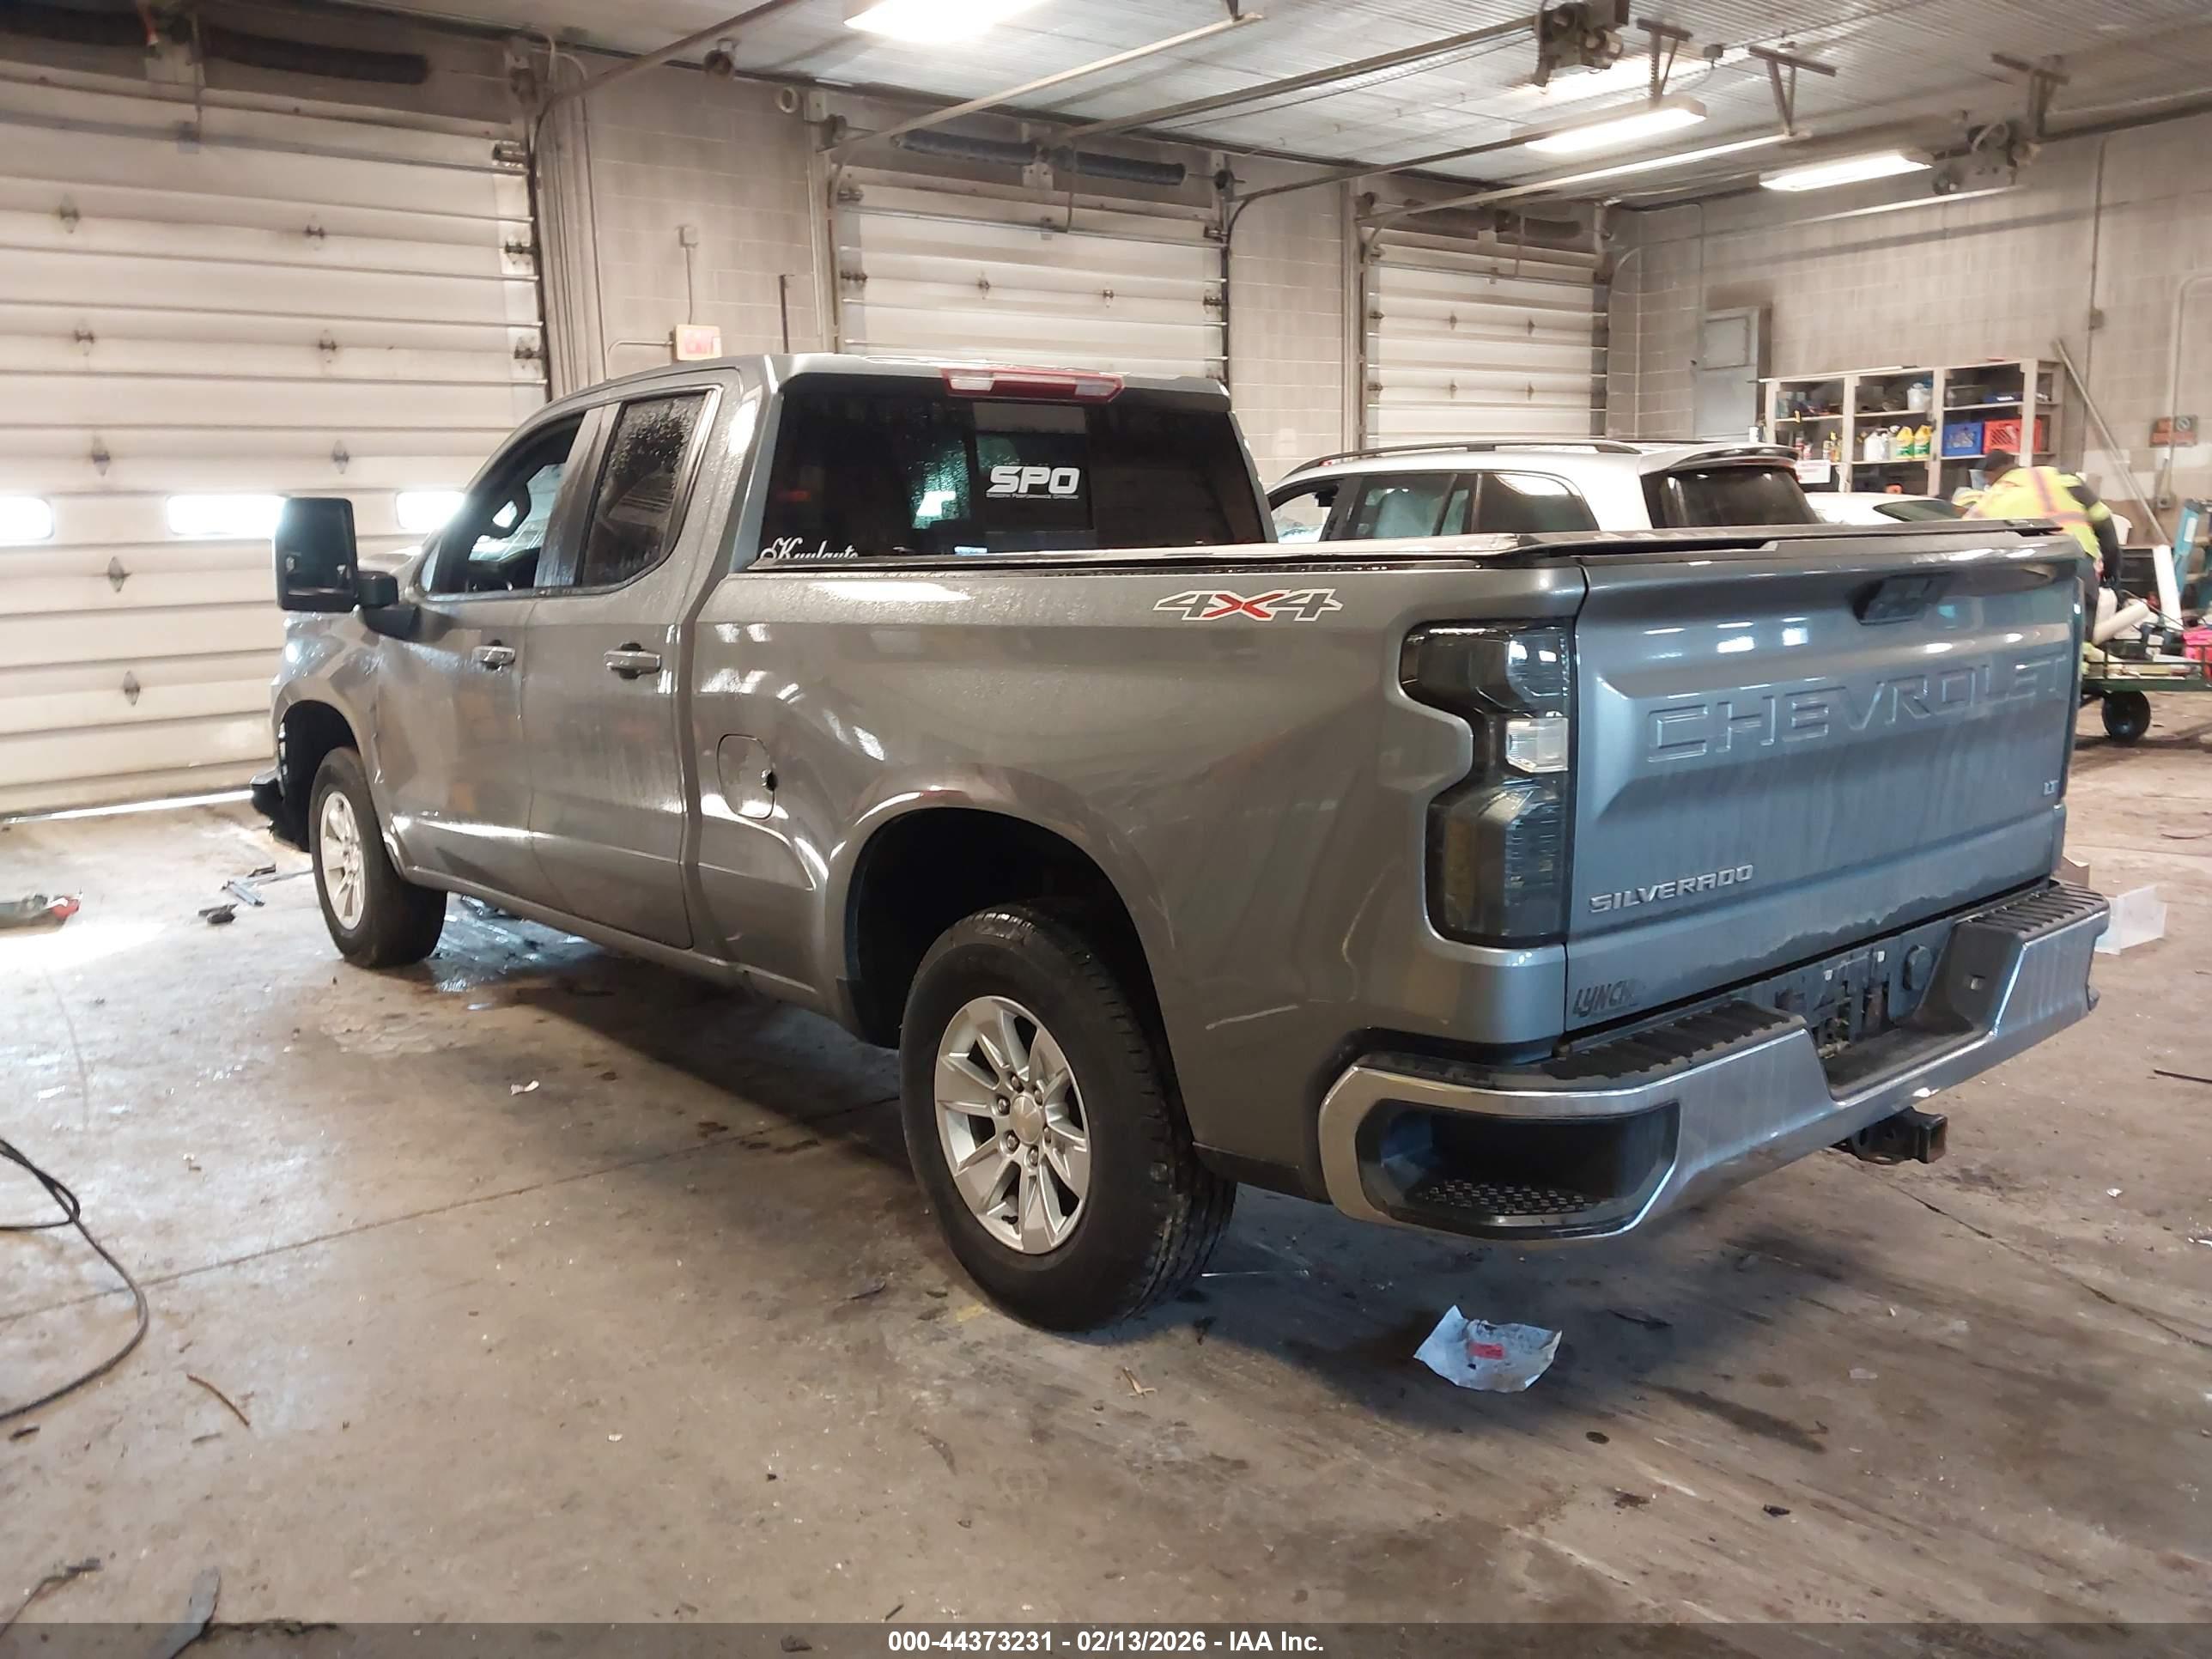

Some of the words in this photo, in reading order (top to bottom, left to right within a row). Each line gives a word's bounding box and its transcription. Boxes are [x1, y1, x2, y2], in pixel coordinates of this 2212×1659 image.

[986, 465, 1080, 495] SPO
[1647, 653, 2068, 763] CHEVROLET
[1589, 864, 1754, 914] SILVERADO
